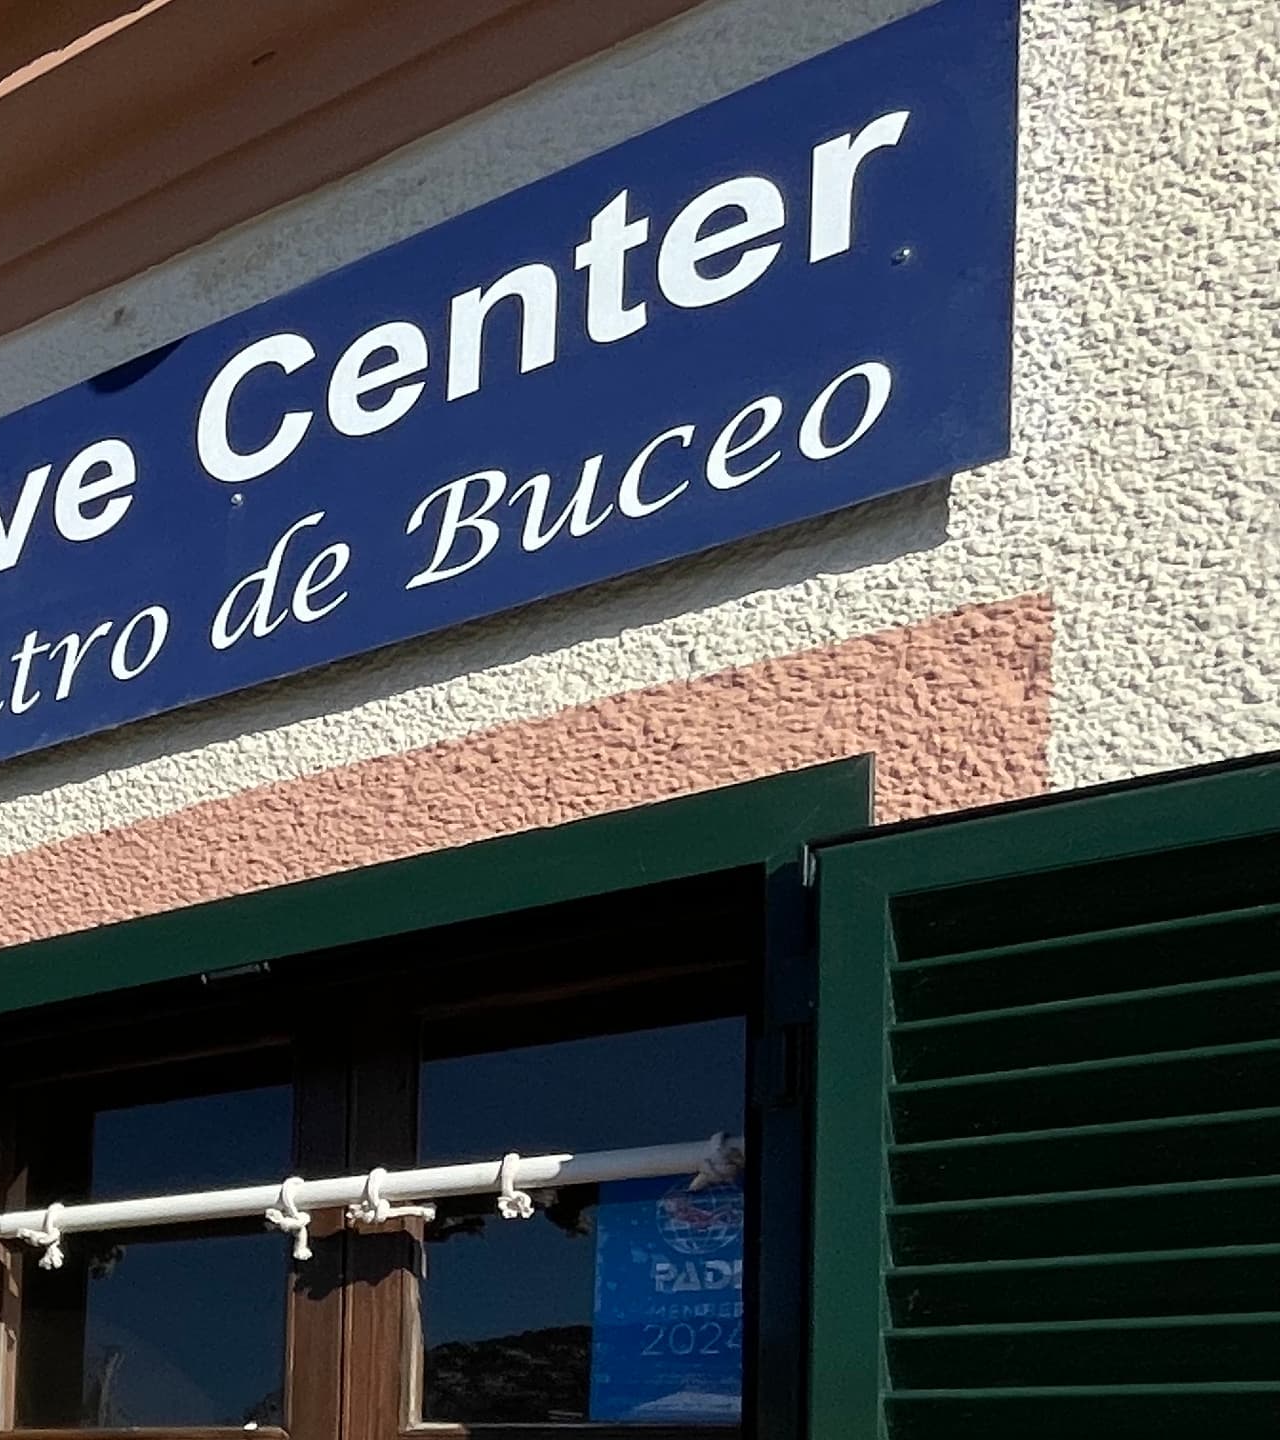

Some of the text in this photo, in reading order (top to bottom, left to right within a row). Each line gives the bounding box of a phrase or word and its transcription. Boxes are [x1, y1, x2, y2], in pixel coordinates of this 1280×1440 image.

[196, 109, 911, 484] Center
[211, 510, 351, 651] de
[405, 361, 893, 591] Buceo
[655, 1259, 743, 1292] PADI
